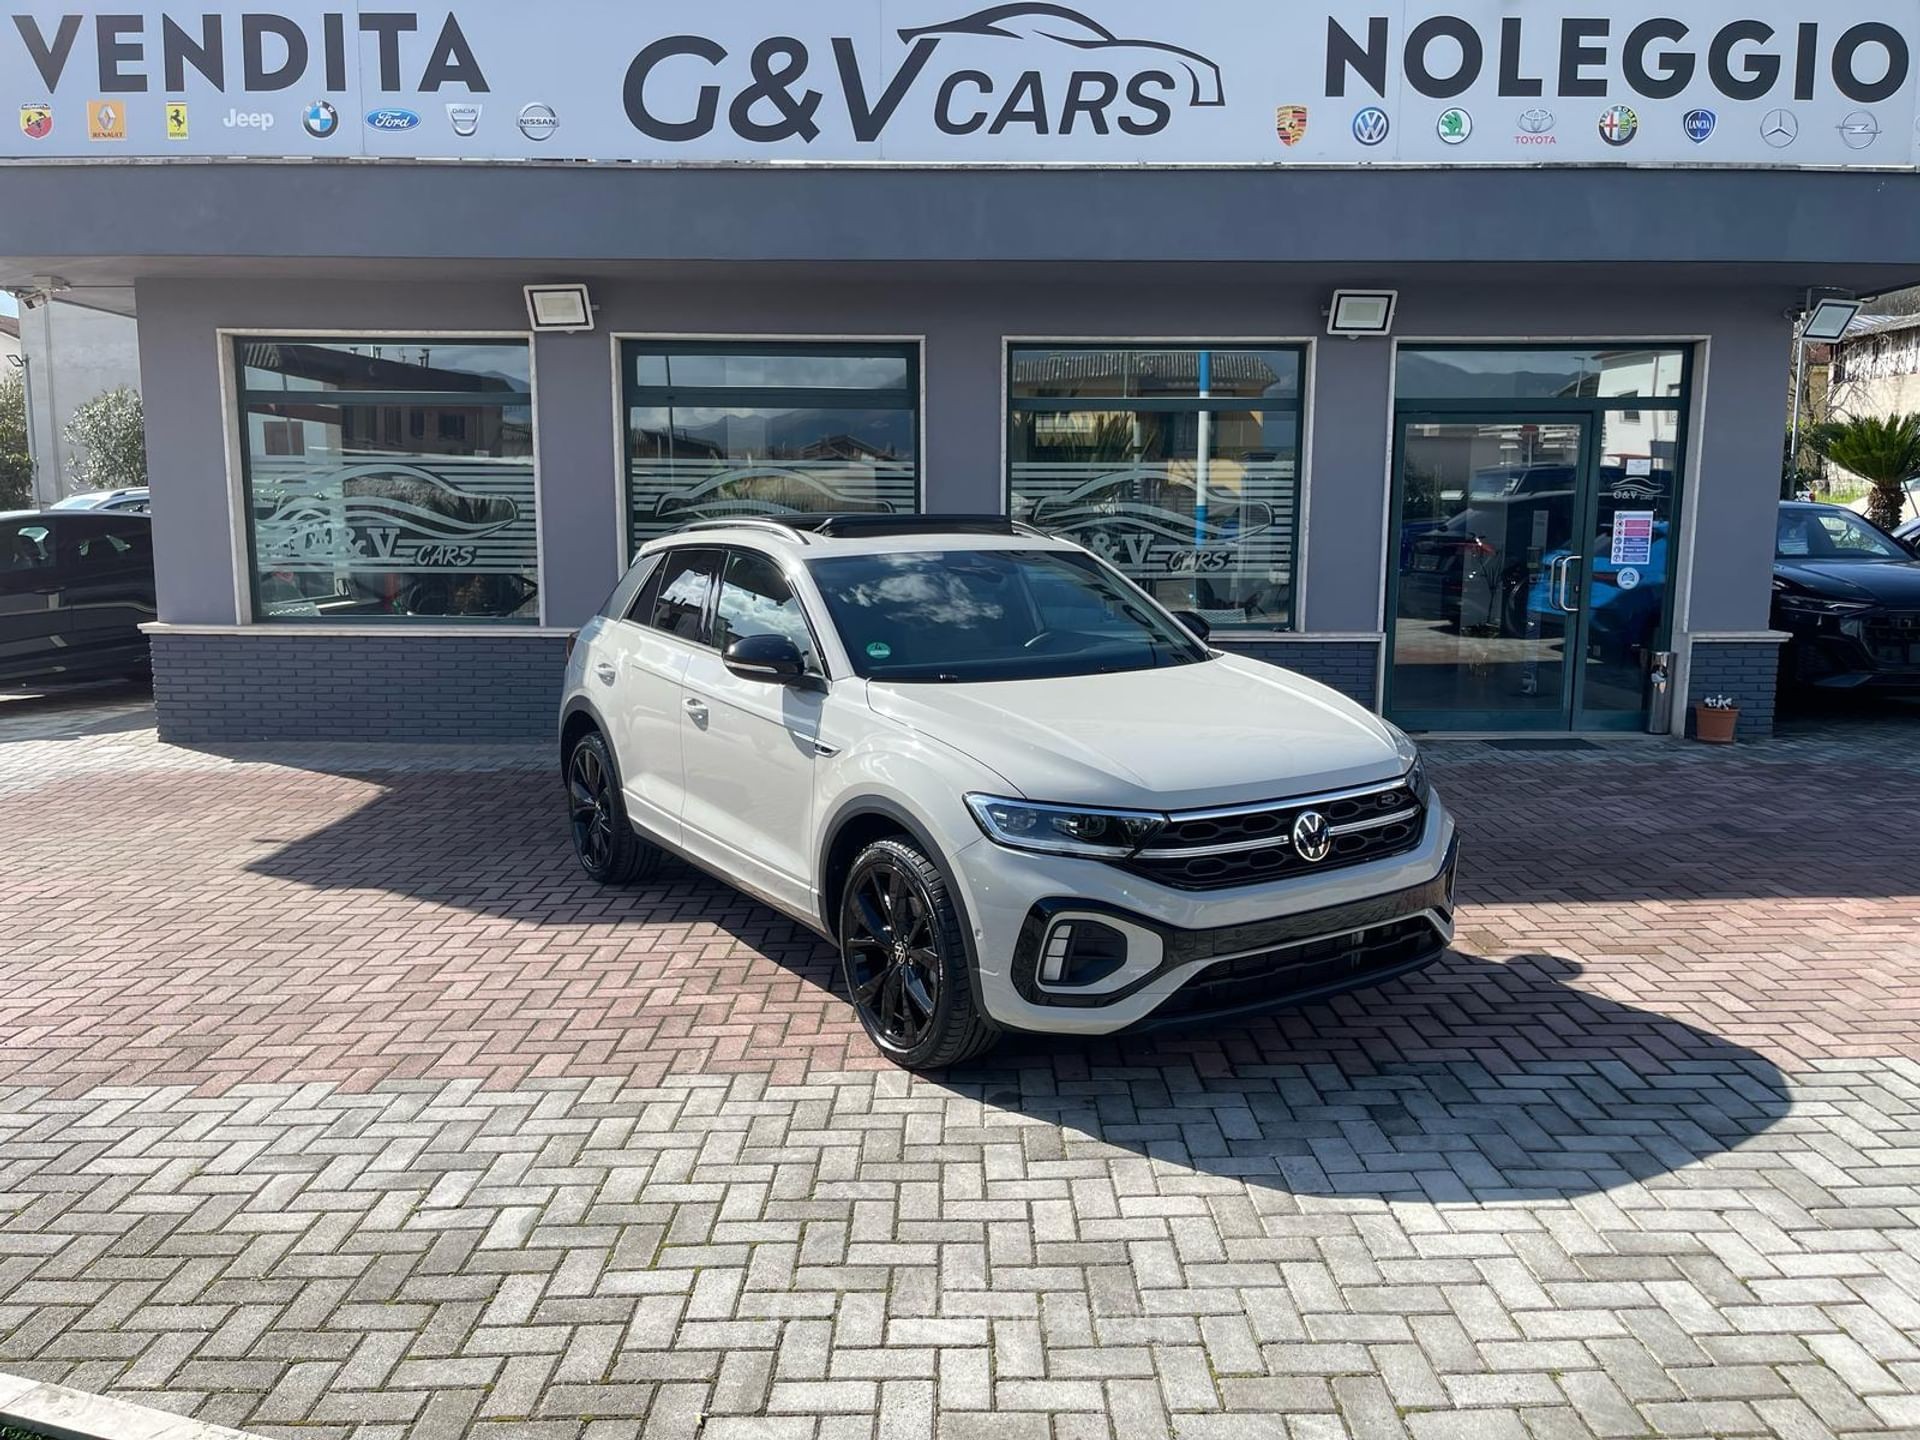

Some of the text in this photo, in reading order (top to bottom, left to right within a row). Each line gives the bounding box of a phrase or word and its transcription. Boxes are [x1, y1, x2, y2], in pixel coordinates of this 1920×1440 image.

[12, 12, 490, 94] VENDITA
[1324, 15, 1909, 103] NOLEGGIO
[622, 35, 1175, 144] G&V CARS
[223, 108, 274, 131] Jeep
[375, 111, 410, 128] Ford
[519, 118, 557, 126] NISSAN
[1688, 120, 1710, 130] LANCIA
[1513, 135, 1556, 145] TOYOTA
[415, 545, 477, 567] CARS
[1168, 550, 1229, 571] CARS
